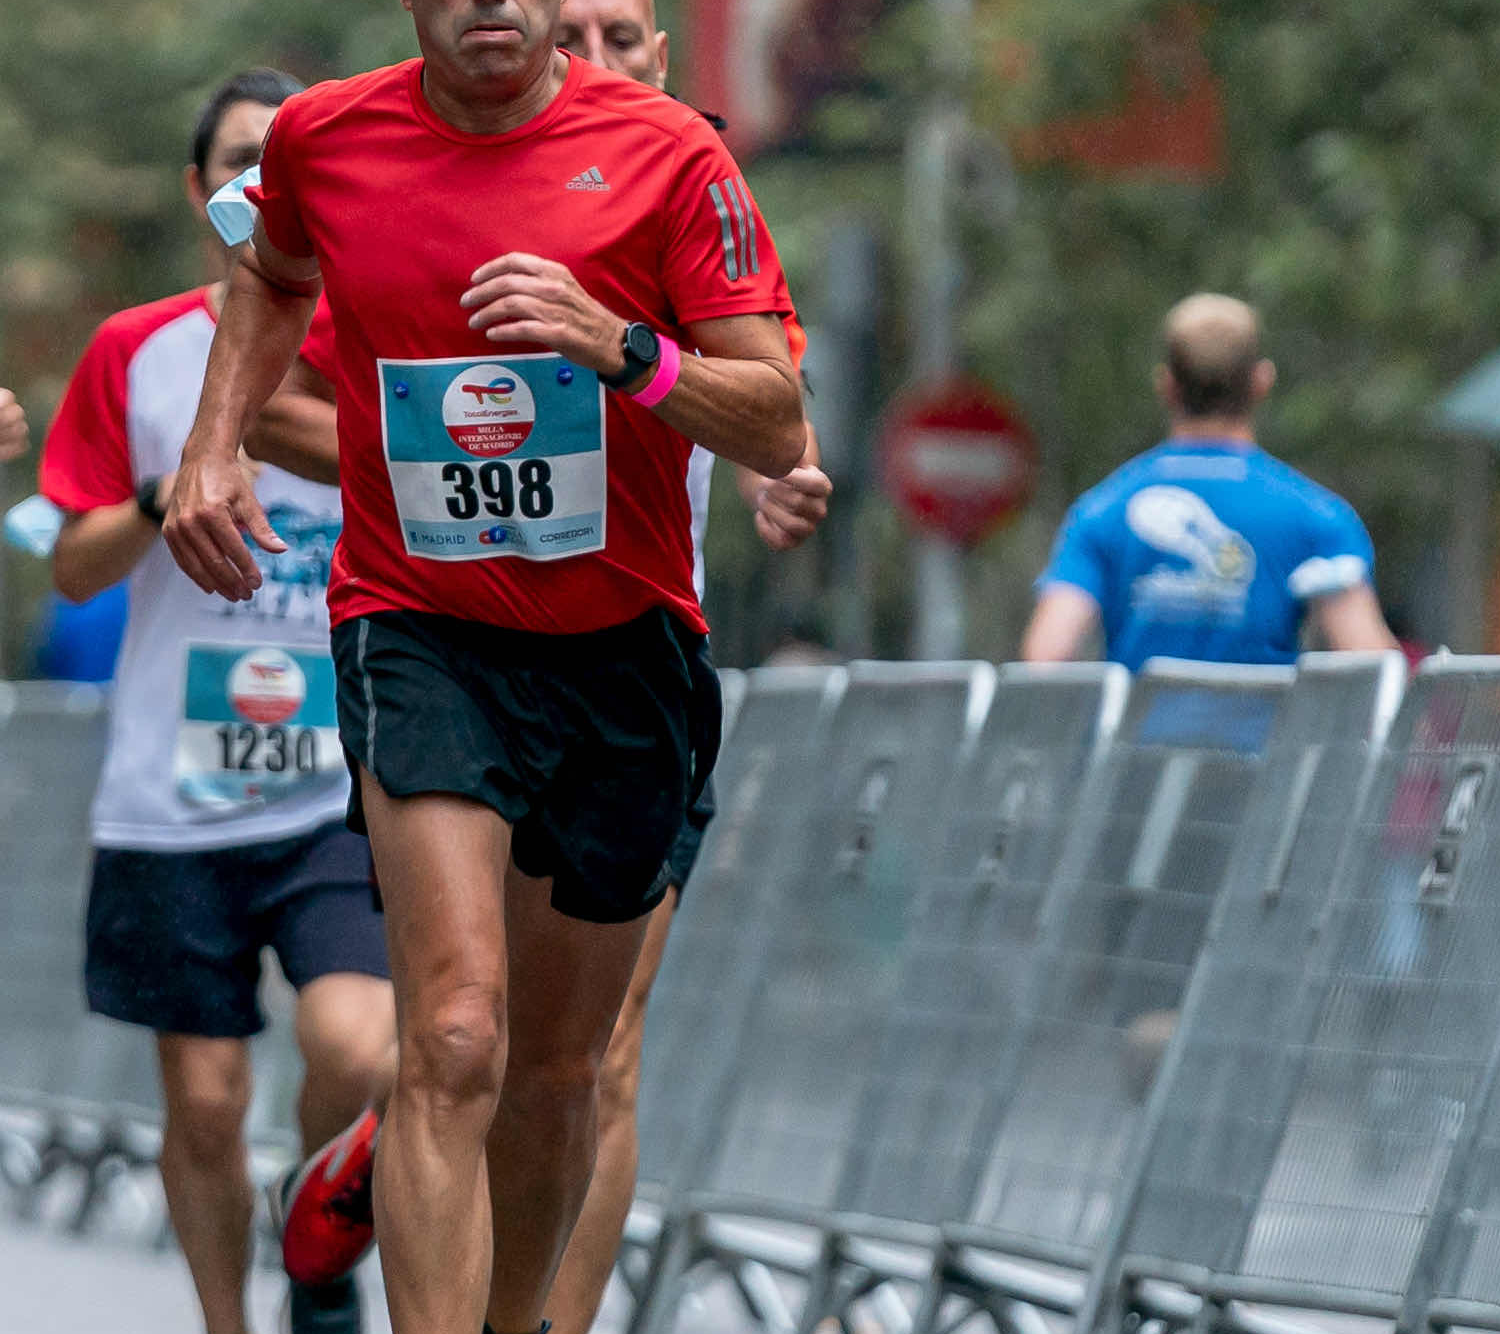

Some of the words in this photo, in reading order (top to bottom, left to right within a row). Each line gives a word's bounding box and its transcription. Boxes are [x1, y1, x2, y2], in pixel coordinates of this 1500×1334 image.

[566, 180, 610, 191] adidas
[442, 459, 554, 520] 398
[421, 533, 466, 545] MADRID
[217, 725, 316, 772] 1230
